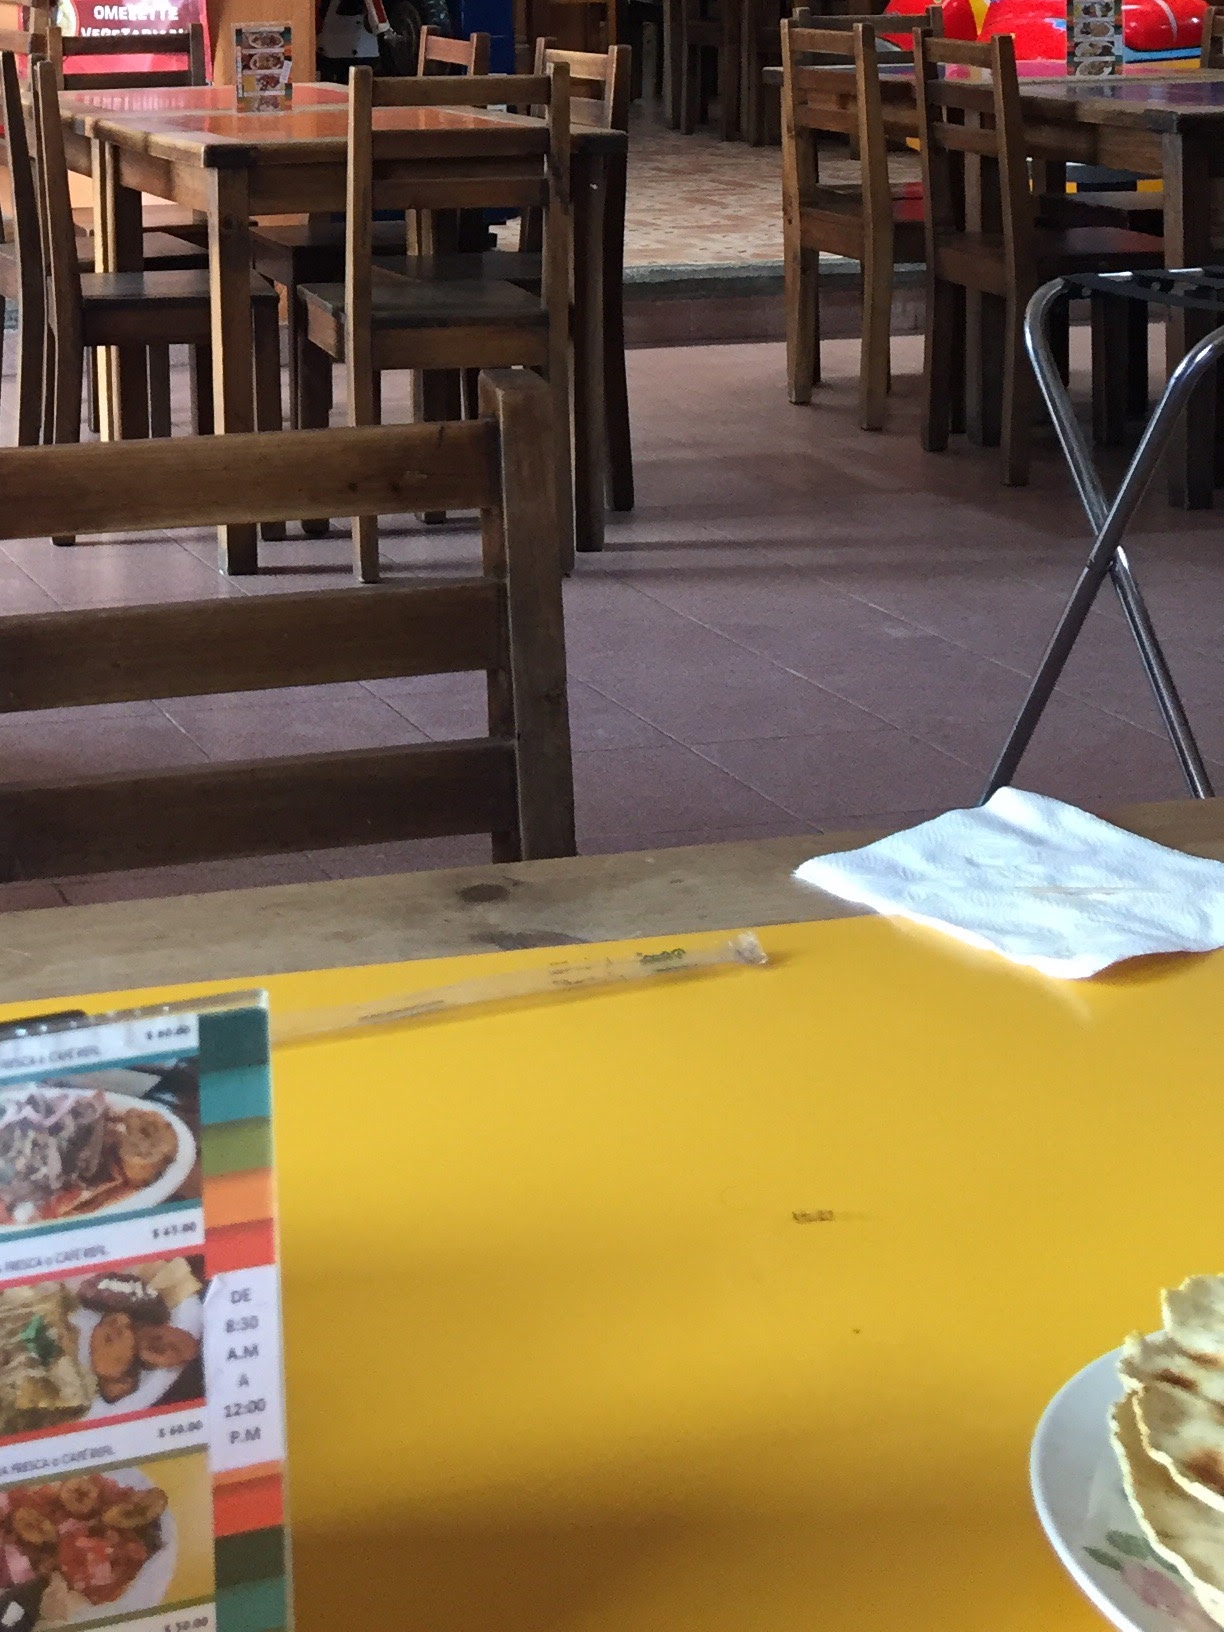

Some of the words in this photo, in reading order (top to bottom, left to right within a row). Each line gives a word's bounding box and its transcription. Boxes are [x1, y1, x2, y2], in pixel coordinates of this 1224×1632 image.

[93, 5, 179, 22] OMELETTE
[230, 1287, 252, 1305] DE
[225, 1315, 259, 1334] 8:30
[226, 1343, 260, 1362] A.M
[238, 1372, 250, 1388] A
[223, 1398, 267, 1419] 12:00
[229, 1426, 262, 1445] P.M
